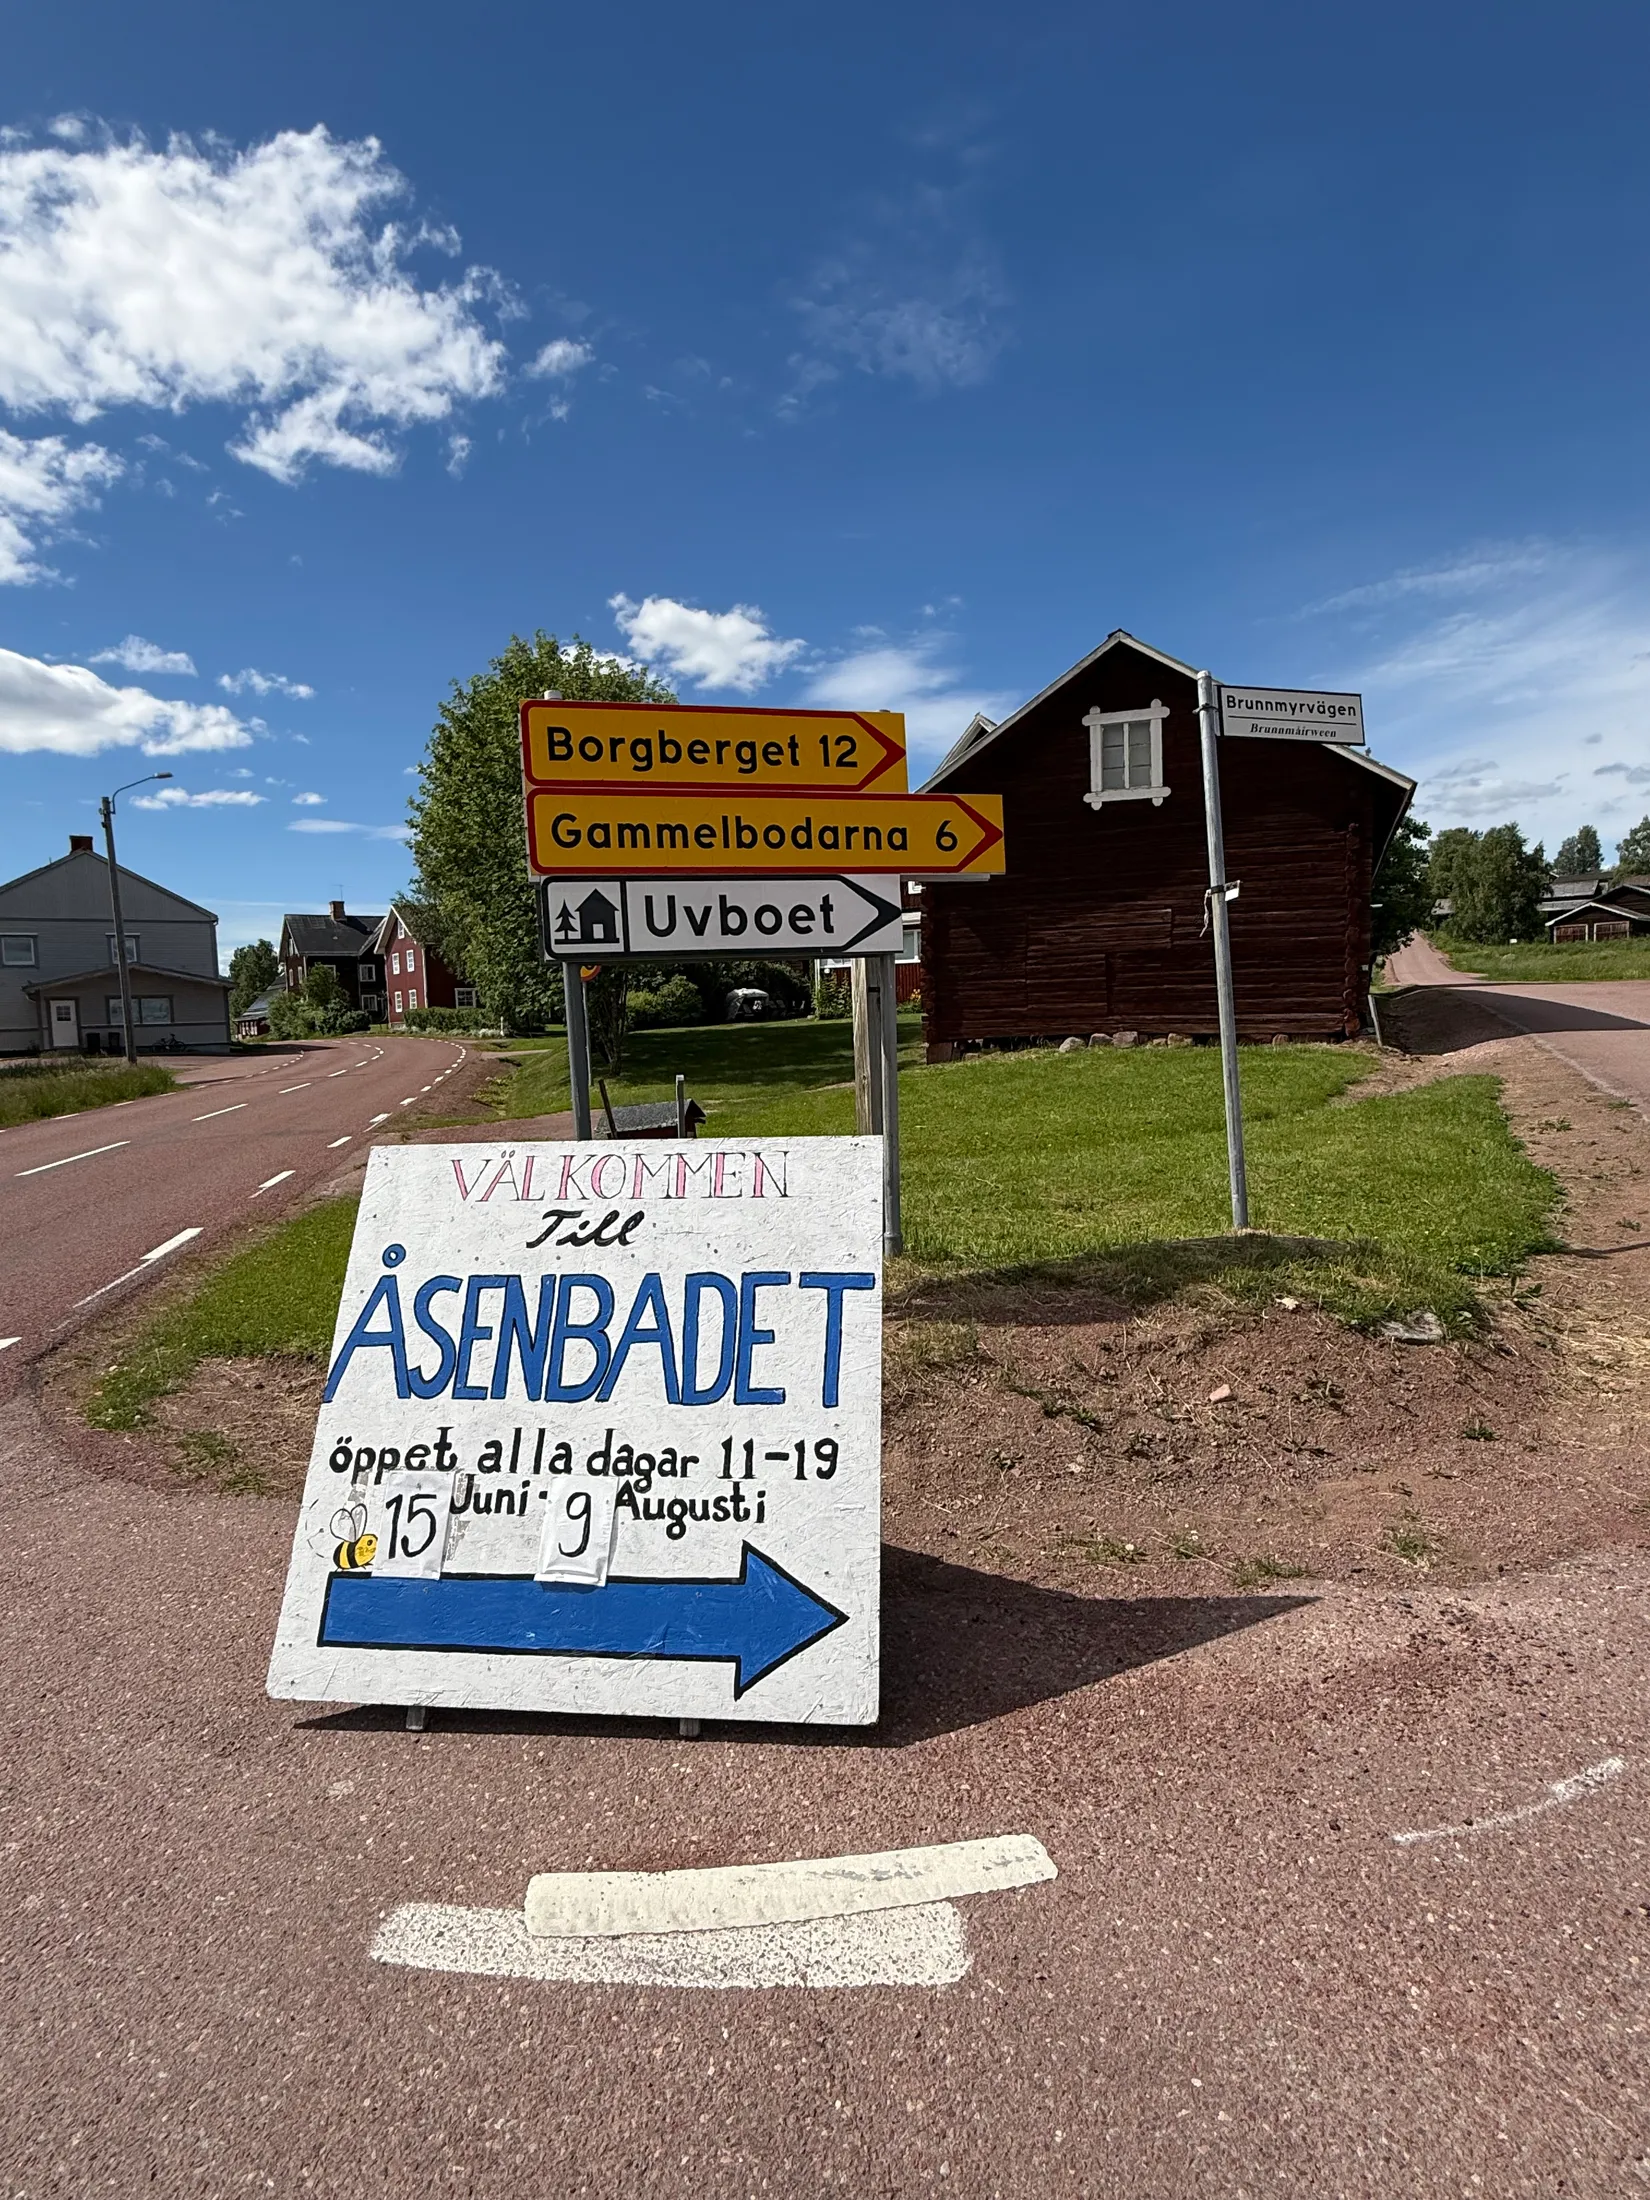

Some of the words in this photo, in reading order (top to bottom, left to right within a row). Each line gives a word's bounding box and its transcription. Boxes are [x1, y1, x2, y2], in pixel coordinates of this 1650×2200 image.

[1226, 694, 1357, 719] Brunnmyrvägen
[546, 726, 801, 773] Borgberget
[818, 734, 858, 769] 12
[551, 813, 909, 852] Gammelbodarna
[935, 820, 959, 853] 6
[644, 893, 836, 938] Uvboet
[451, 1150, 793, 1202] VÄLKOMMEN
[525, 1209, 646, 1249] Till
[323, 1243, 876, 1408] ÅSENBADET
[329, 1426, 458, 1487] öppet
[477, 1427, 573, 1475] alla
[586, 1428, 700, 1494] dagar
[385, 1493, 437, 1559] 15
[558, 1491, 592, 1558] 9
[615, 1480, 767, 1540] Augusti
